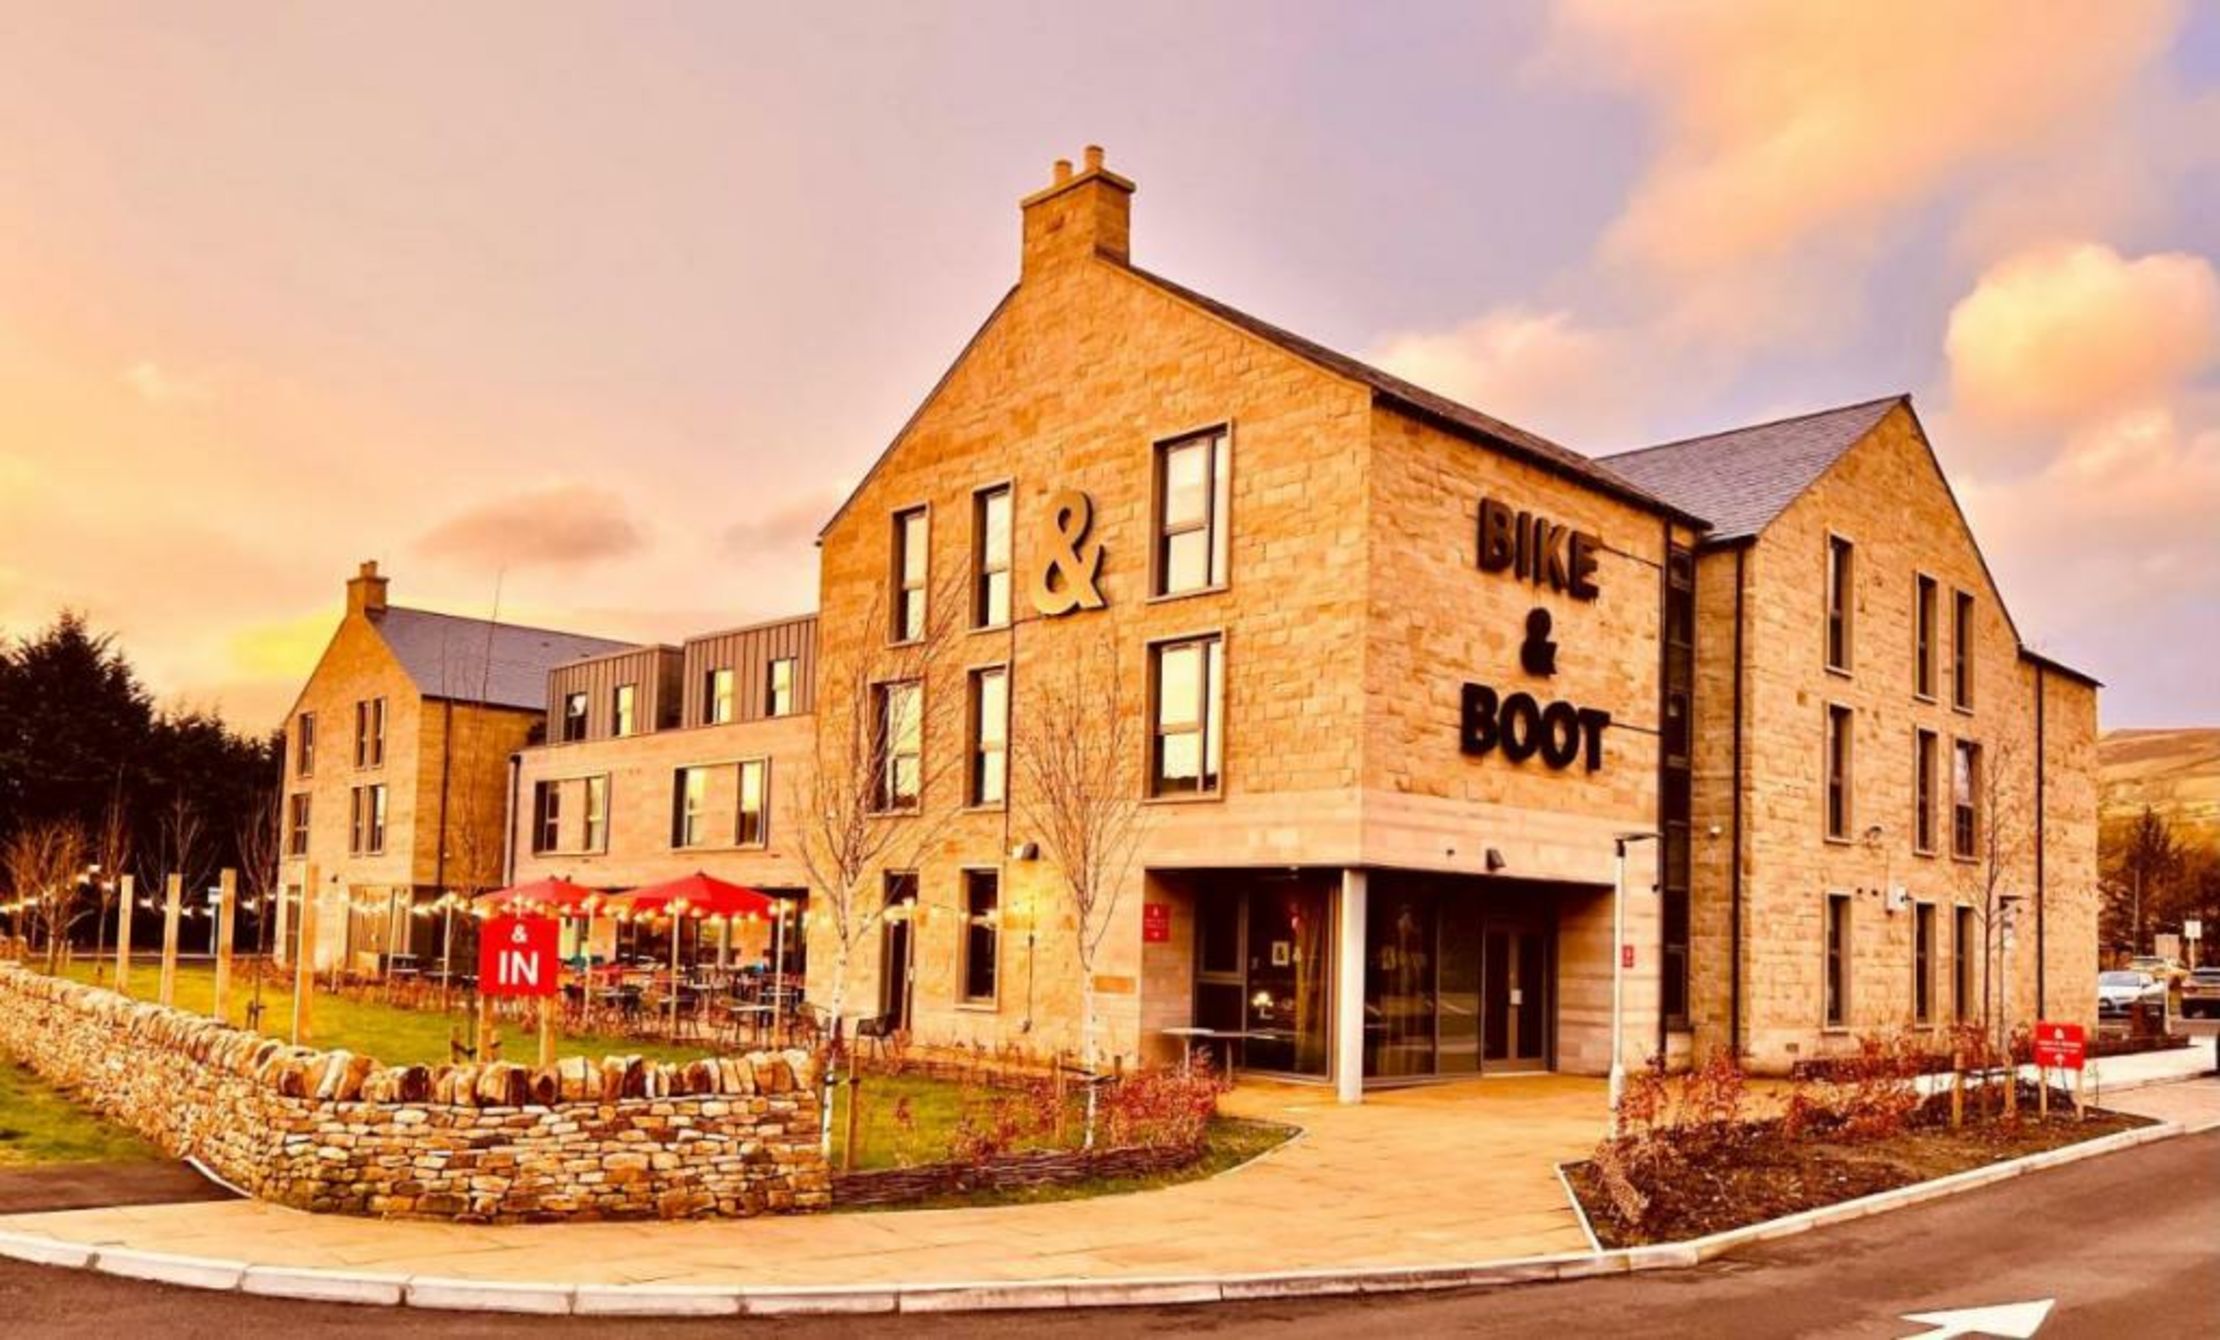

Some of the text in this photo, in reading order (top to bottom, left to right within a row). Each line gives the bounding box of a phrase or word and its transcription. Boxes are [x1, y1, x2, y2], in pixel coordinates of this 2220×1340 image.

[1476, 497, 1602, 602] BIKE
[1520, 606, 1557, 679] &
[1459, 681, 1611, 774] BOOT
[498, 949, 539, 986] IN
[511, 923, 528, 944] &
